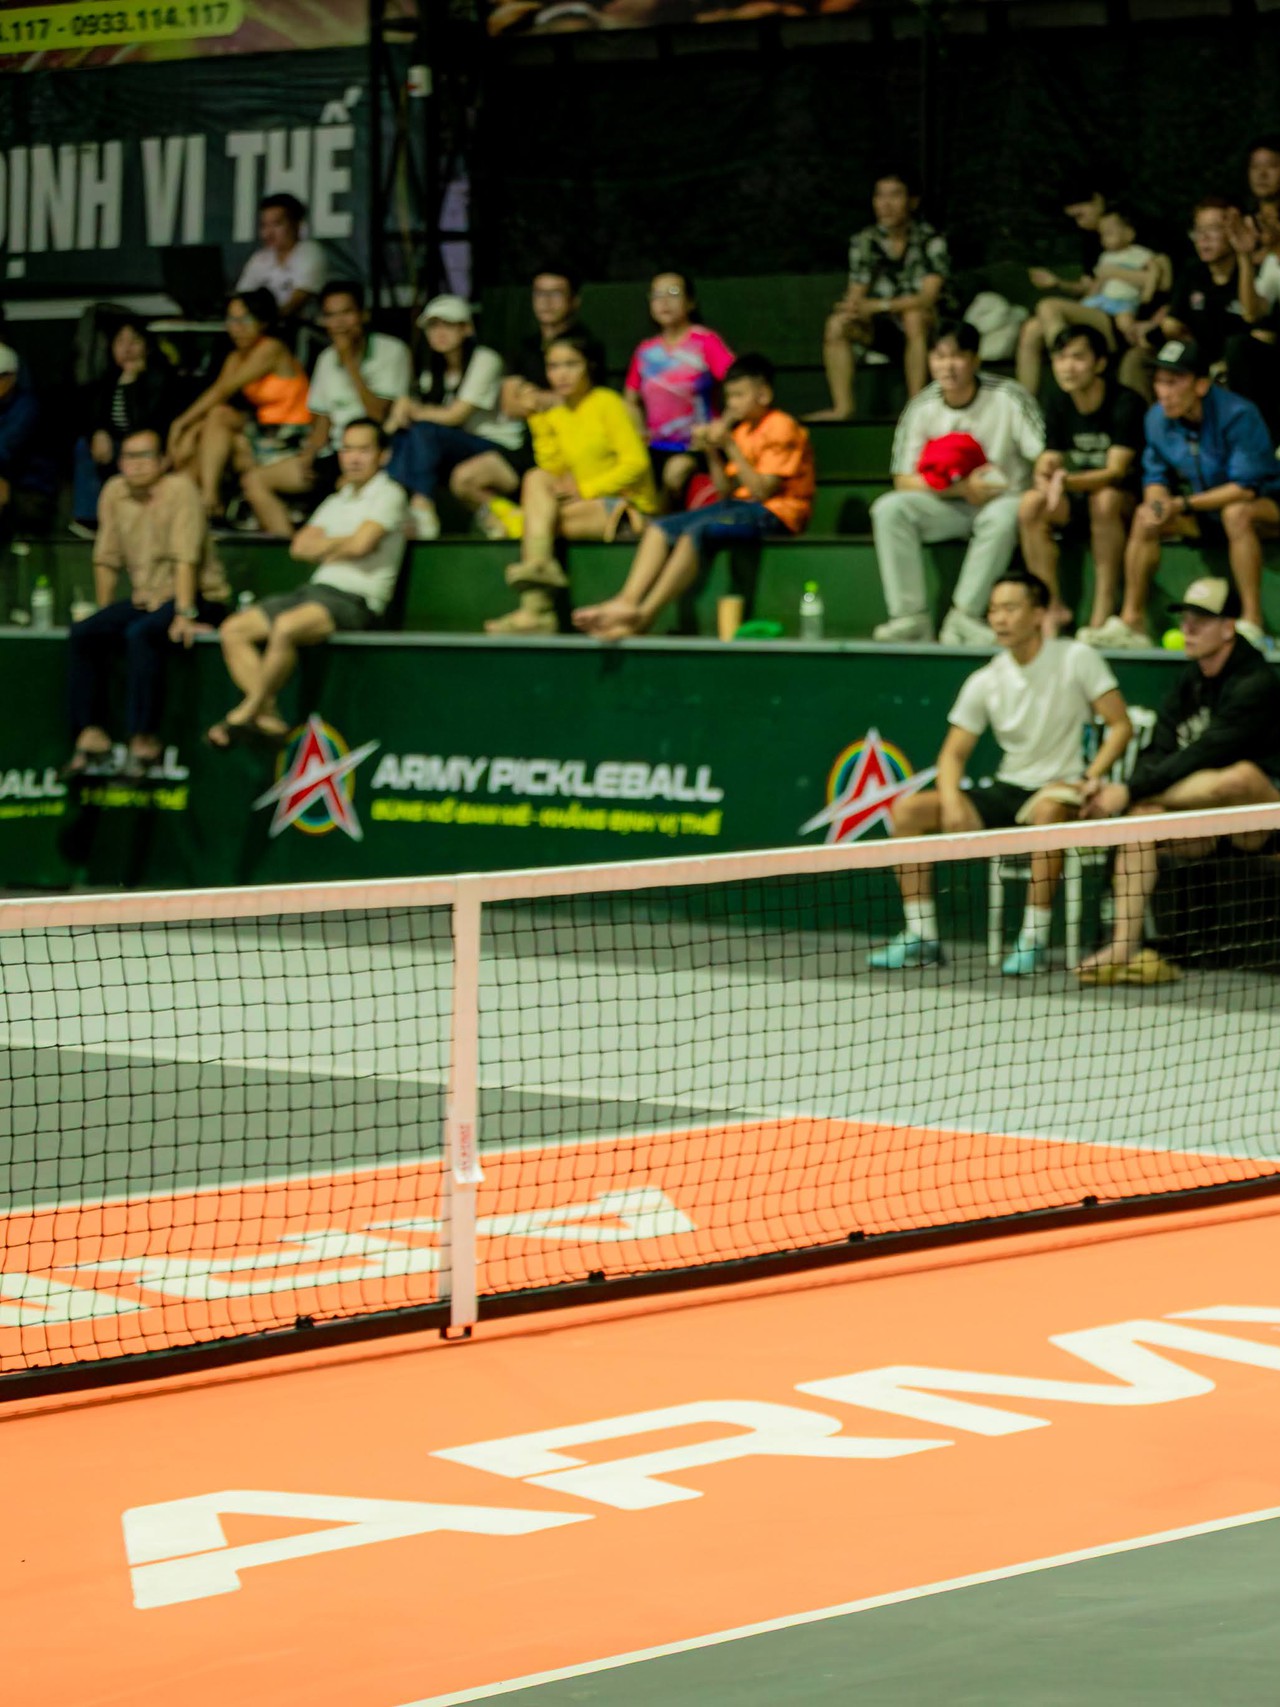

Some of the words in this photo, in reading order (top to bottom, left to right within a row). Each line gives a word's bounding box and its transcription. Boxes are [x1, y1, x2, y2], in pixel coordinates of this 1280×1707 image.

[0, 18, 50, 42] .117
[71, 2, 230, 37] 0933.114.117
[0, 140, 123, 279] ỊNH
[225, 86, 363, 243] THẾ
[0, 767, 68, 800] ALL
[371, 753, 489, 793] ARMY
[487, 757, 725, 803] PICKLEBALL
